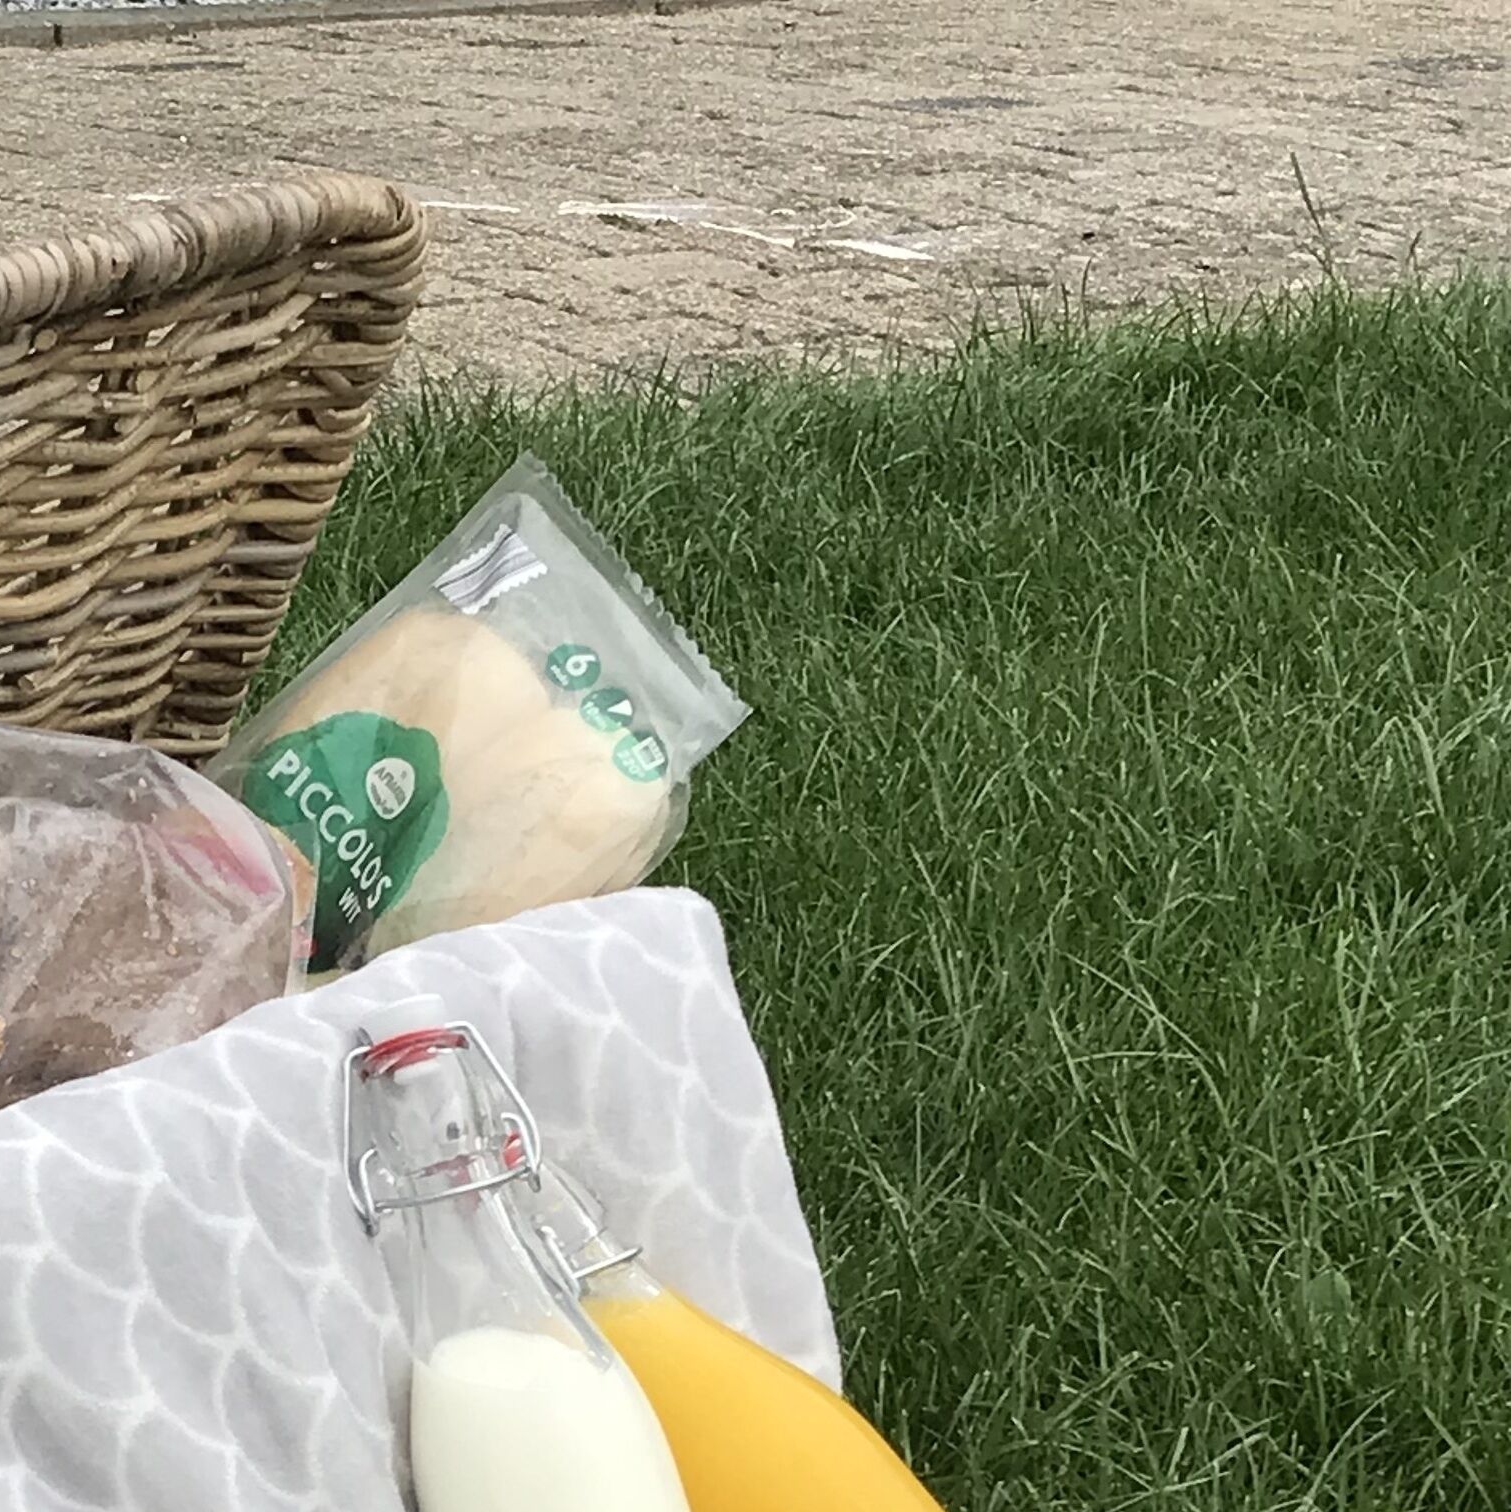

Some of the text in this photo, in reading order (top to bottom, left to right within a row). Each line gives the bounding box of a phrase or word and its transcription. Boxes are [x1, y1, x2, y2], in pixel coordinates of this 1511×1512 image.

[566, 654, 596, 677] 6
[267, 748, 392, 910] PICCOLOS
[338, 887, 362, 924] WIT
